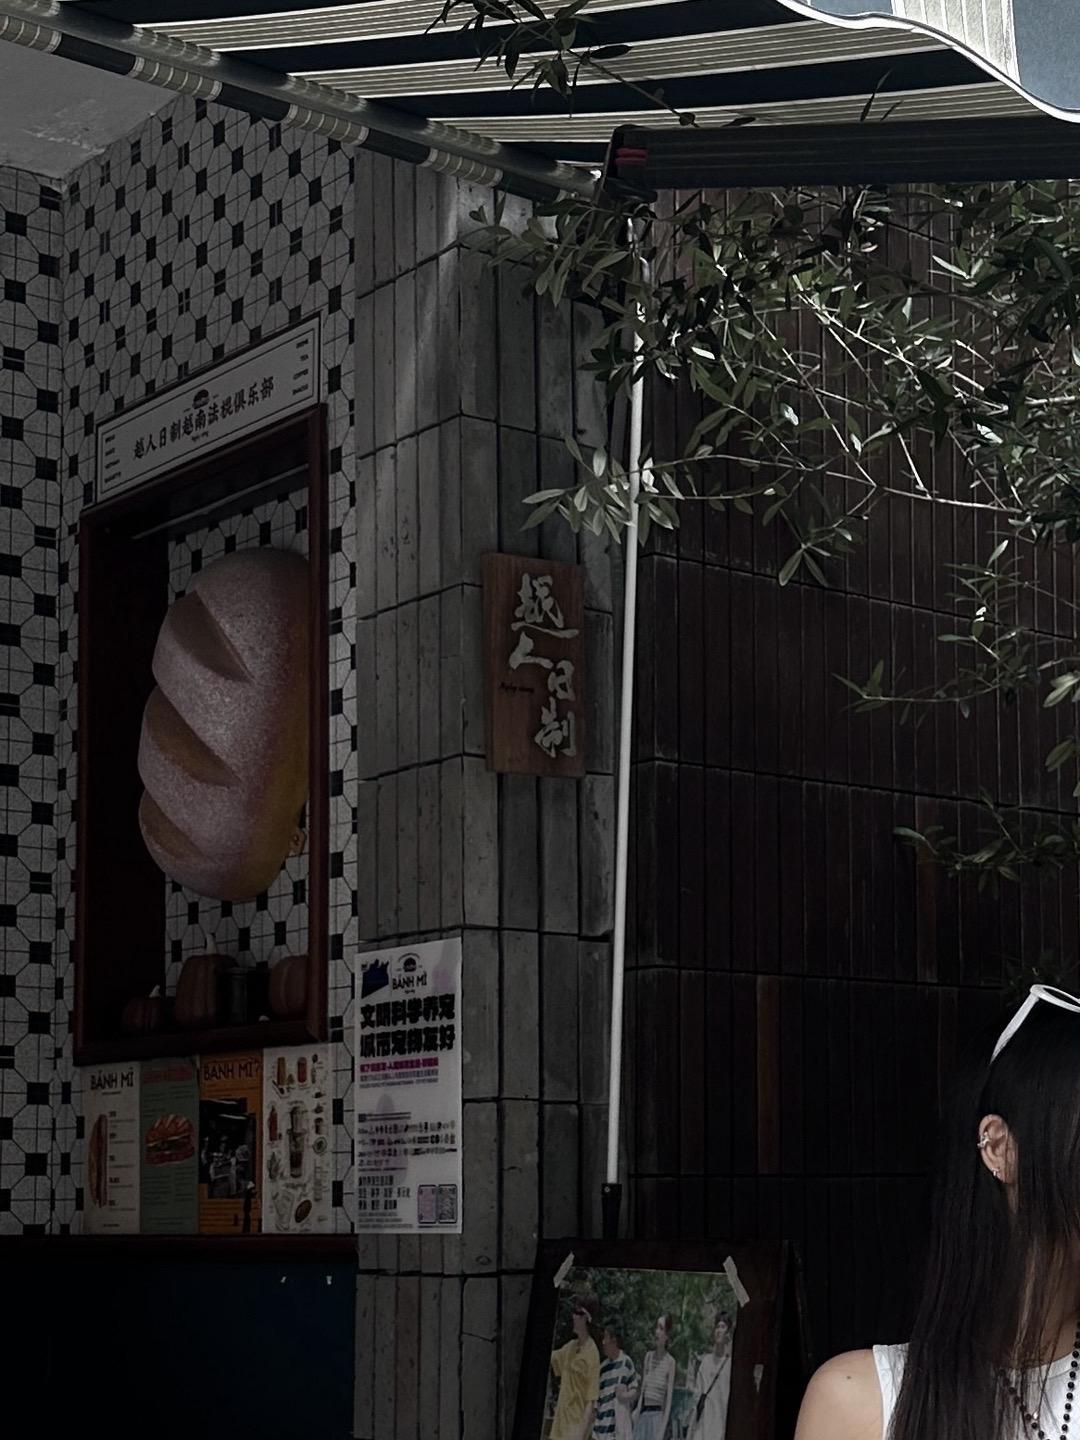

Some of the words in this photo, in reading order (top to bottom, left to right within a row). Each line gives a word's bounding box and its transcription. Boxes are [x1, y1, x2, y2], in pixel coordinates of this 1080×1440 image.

[133, 376, 274, 459] 越人日制越南法棍俱乐部
